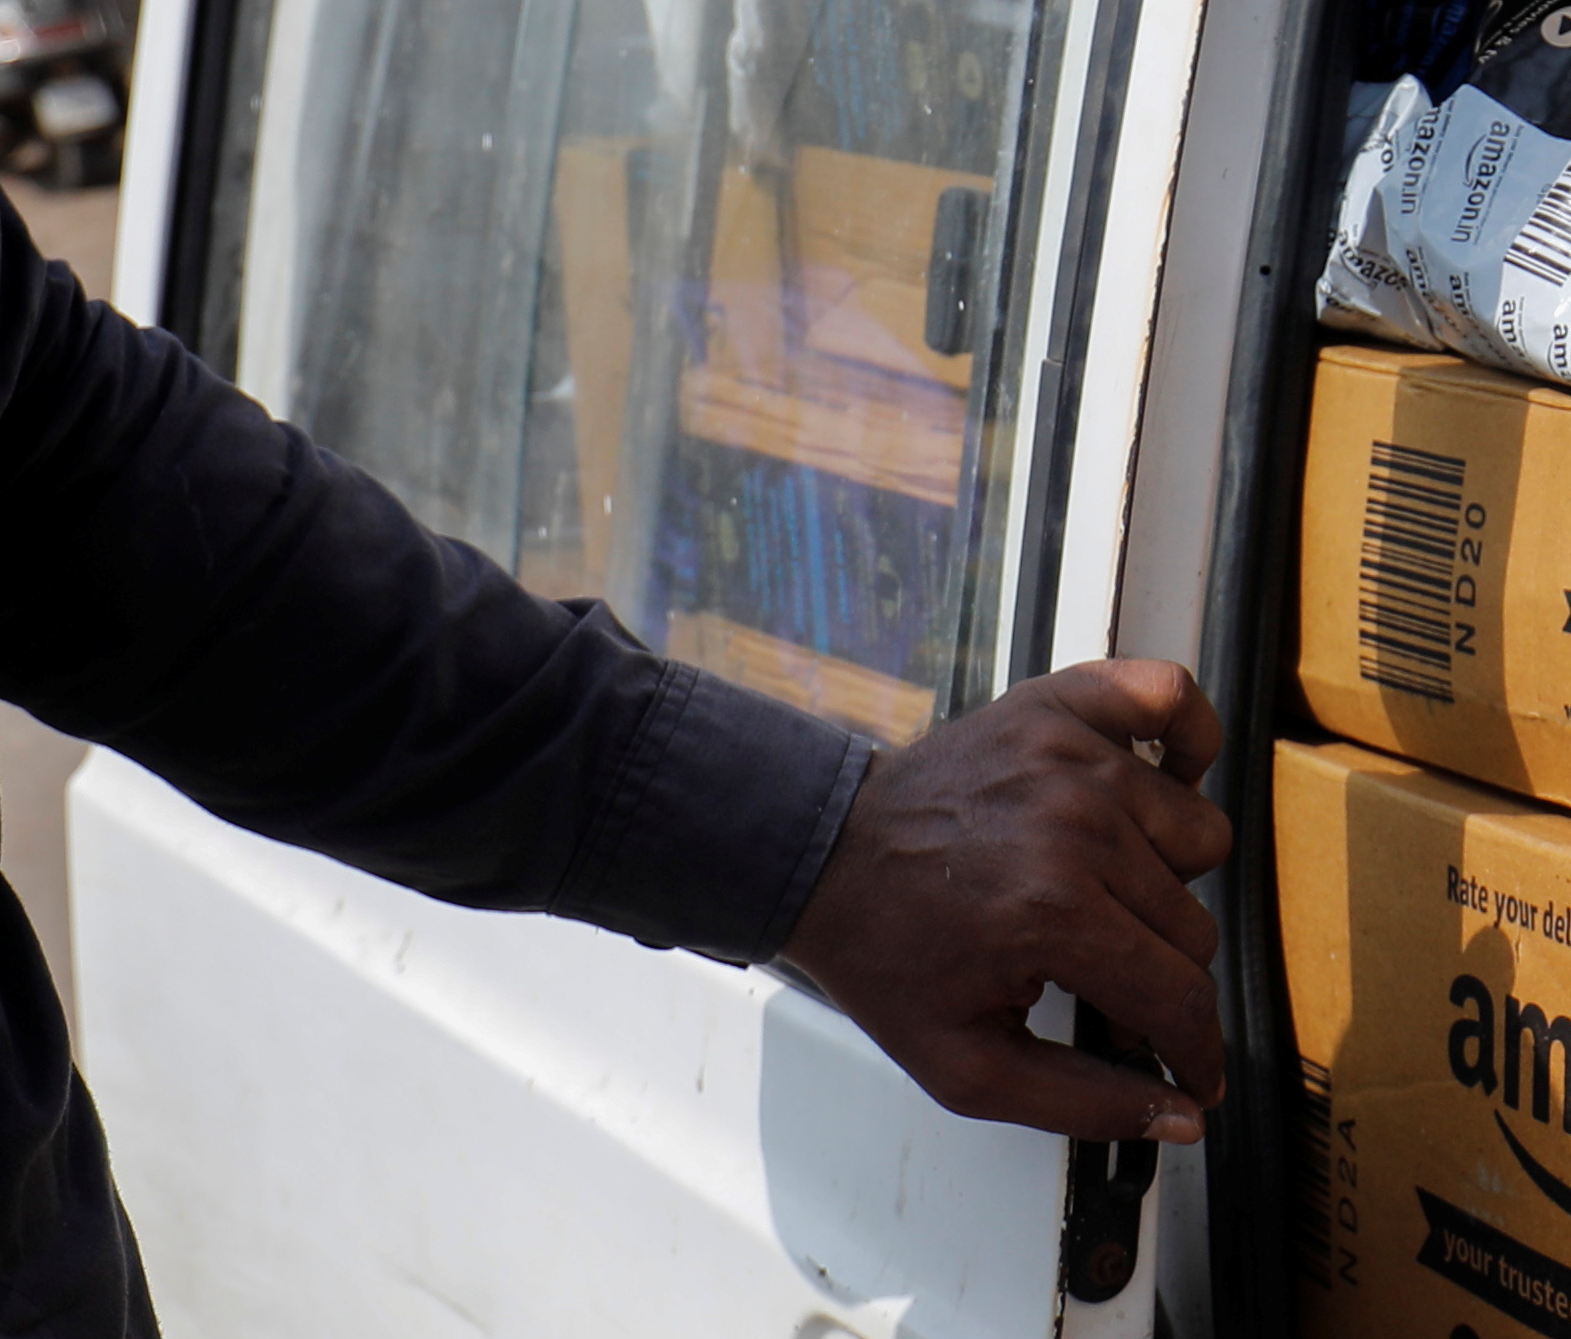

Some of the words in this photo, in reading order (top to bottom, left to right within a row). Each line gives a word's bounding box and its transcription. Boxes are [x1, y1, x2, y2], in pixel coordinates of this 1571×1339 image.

[1450, 119, 1511, 245] amazon.in
[1446, 865, 1490, 915] Rate
[1494, 883, 1538, 930] your
[1443, 1226, 1494, 1277] your
